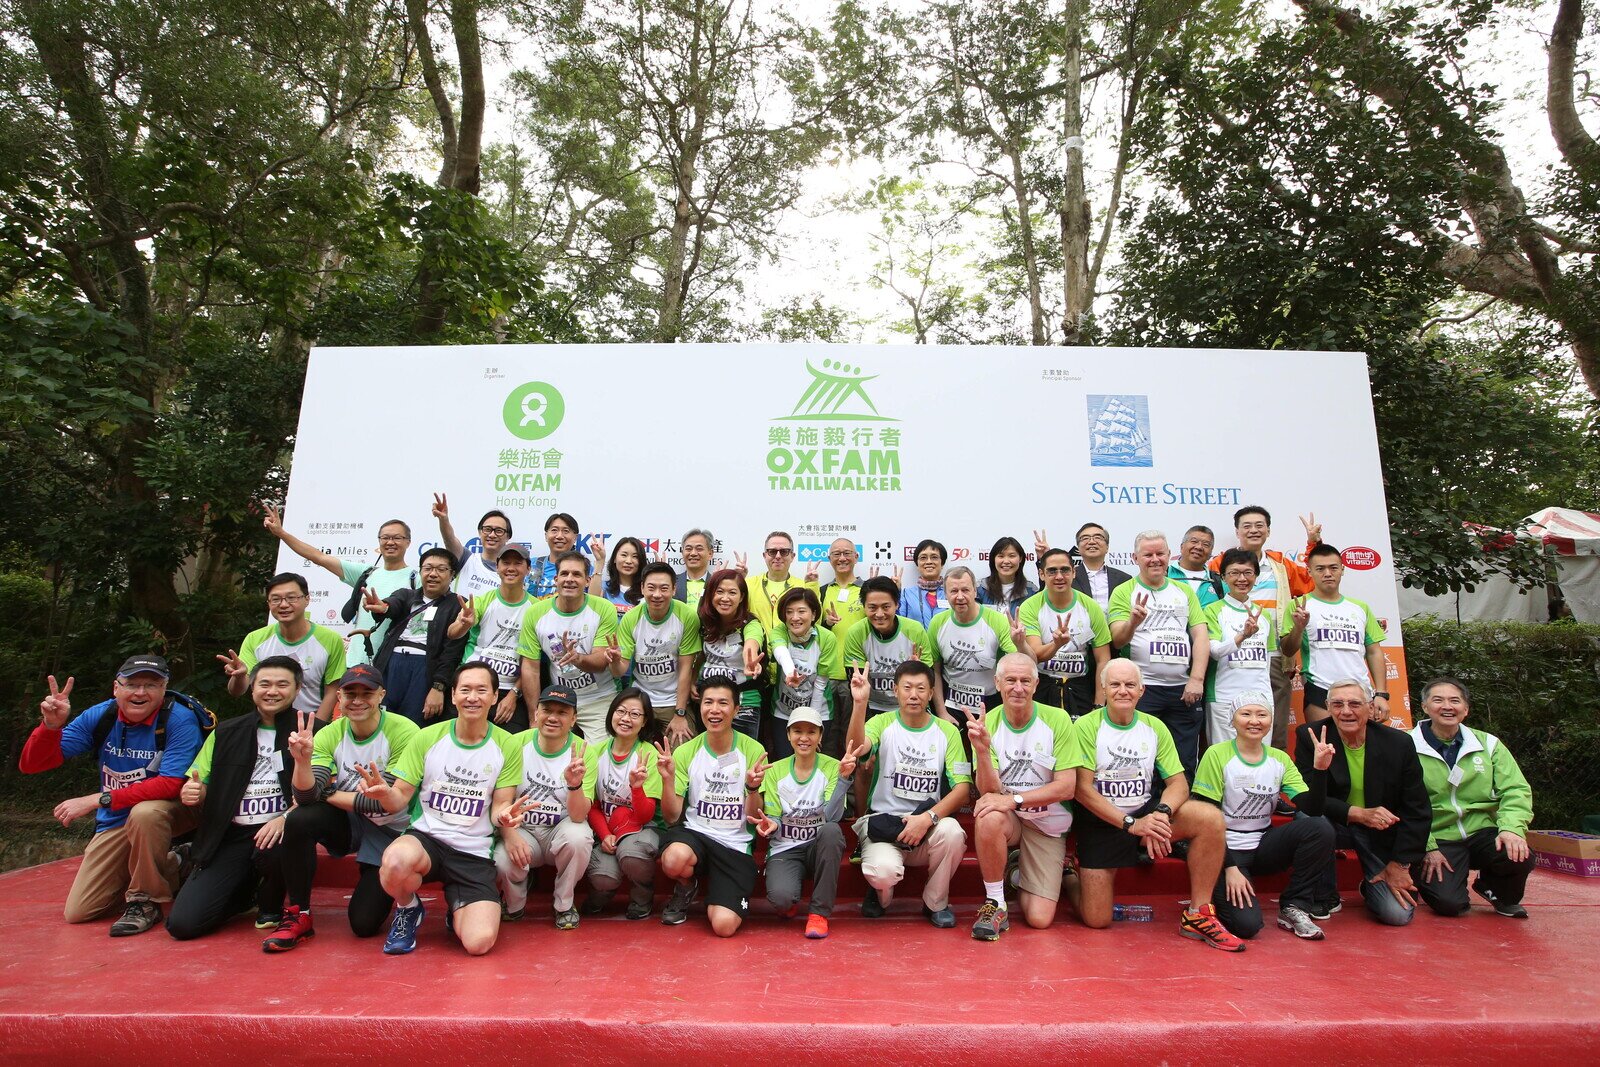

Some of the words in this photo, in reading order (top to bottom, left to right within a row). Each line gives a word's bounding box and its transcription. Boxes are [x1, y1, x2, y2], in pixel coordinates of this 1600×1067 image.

[768, 426, 902, 447] 樂施毅行者
[498, 447, 564, 469] 樂施會
[766, 447, 901, 476] OXFAM
[494, 473, 561, 492] OXFAM
[767, 476, 902, 492] TRAILWALKER
[1091, 482, 1158, 504] STATE
[1162, 483, 1242, 505] STREET
[496, 496, 525, 510] Hong
[528, 496, 557, 510] Kong
[798, 524, 857, 532] 大會指定贊助機構
[337, 546, 368, 555] Miles
[1321, 629, 1357, 644] L0015
[1153, 642, 1187, 657] L0011
[1231, 648, 1265, 662] L0012
[656, 655, 670, 663] 2014
[1046, 660, 1082, 673] L0010
[638, 661, 672, 676] L0005
[949, 688, 982, 707] L0009
[120, 772, 142, 781] 2014
[897, 774, 936, 793] L0026
[465, 788, 483, 797] 2014
[1101, 780, 1144, 797] L0029
[432, 793, 479, 816] L0001
[700, 801, 739, 820] L0023
[523, 811, 556, 826] 0021
[808, 817, 823, 826] 2014
[784, 825, 817, 840] L002
[1556, 857, 1577, 871] vita
